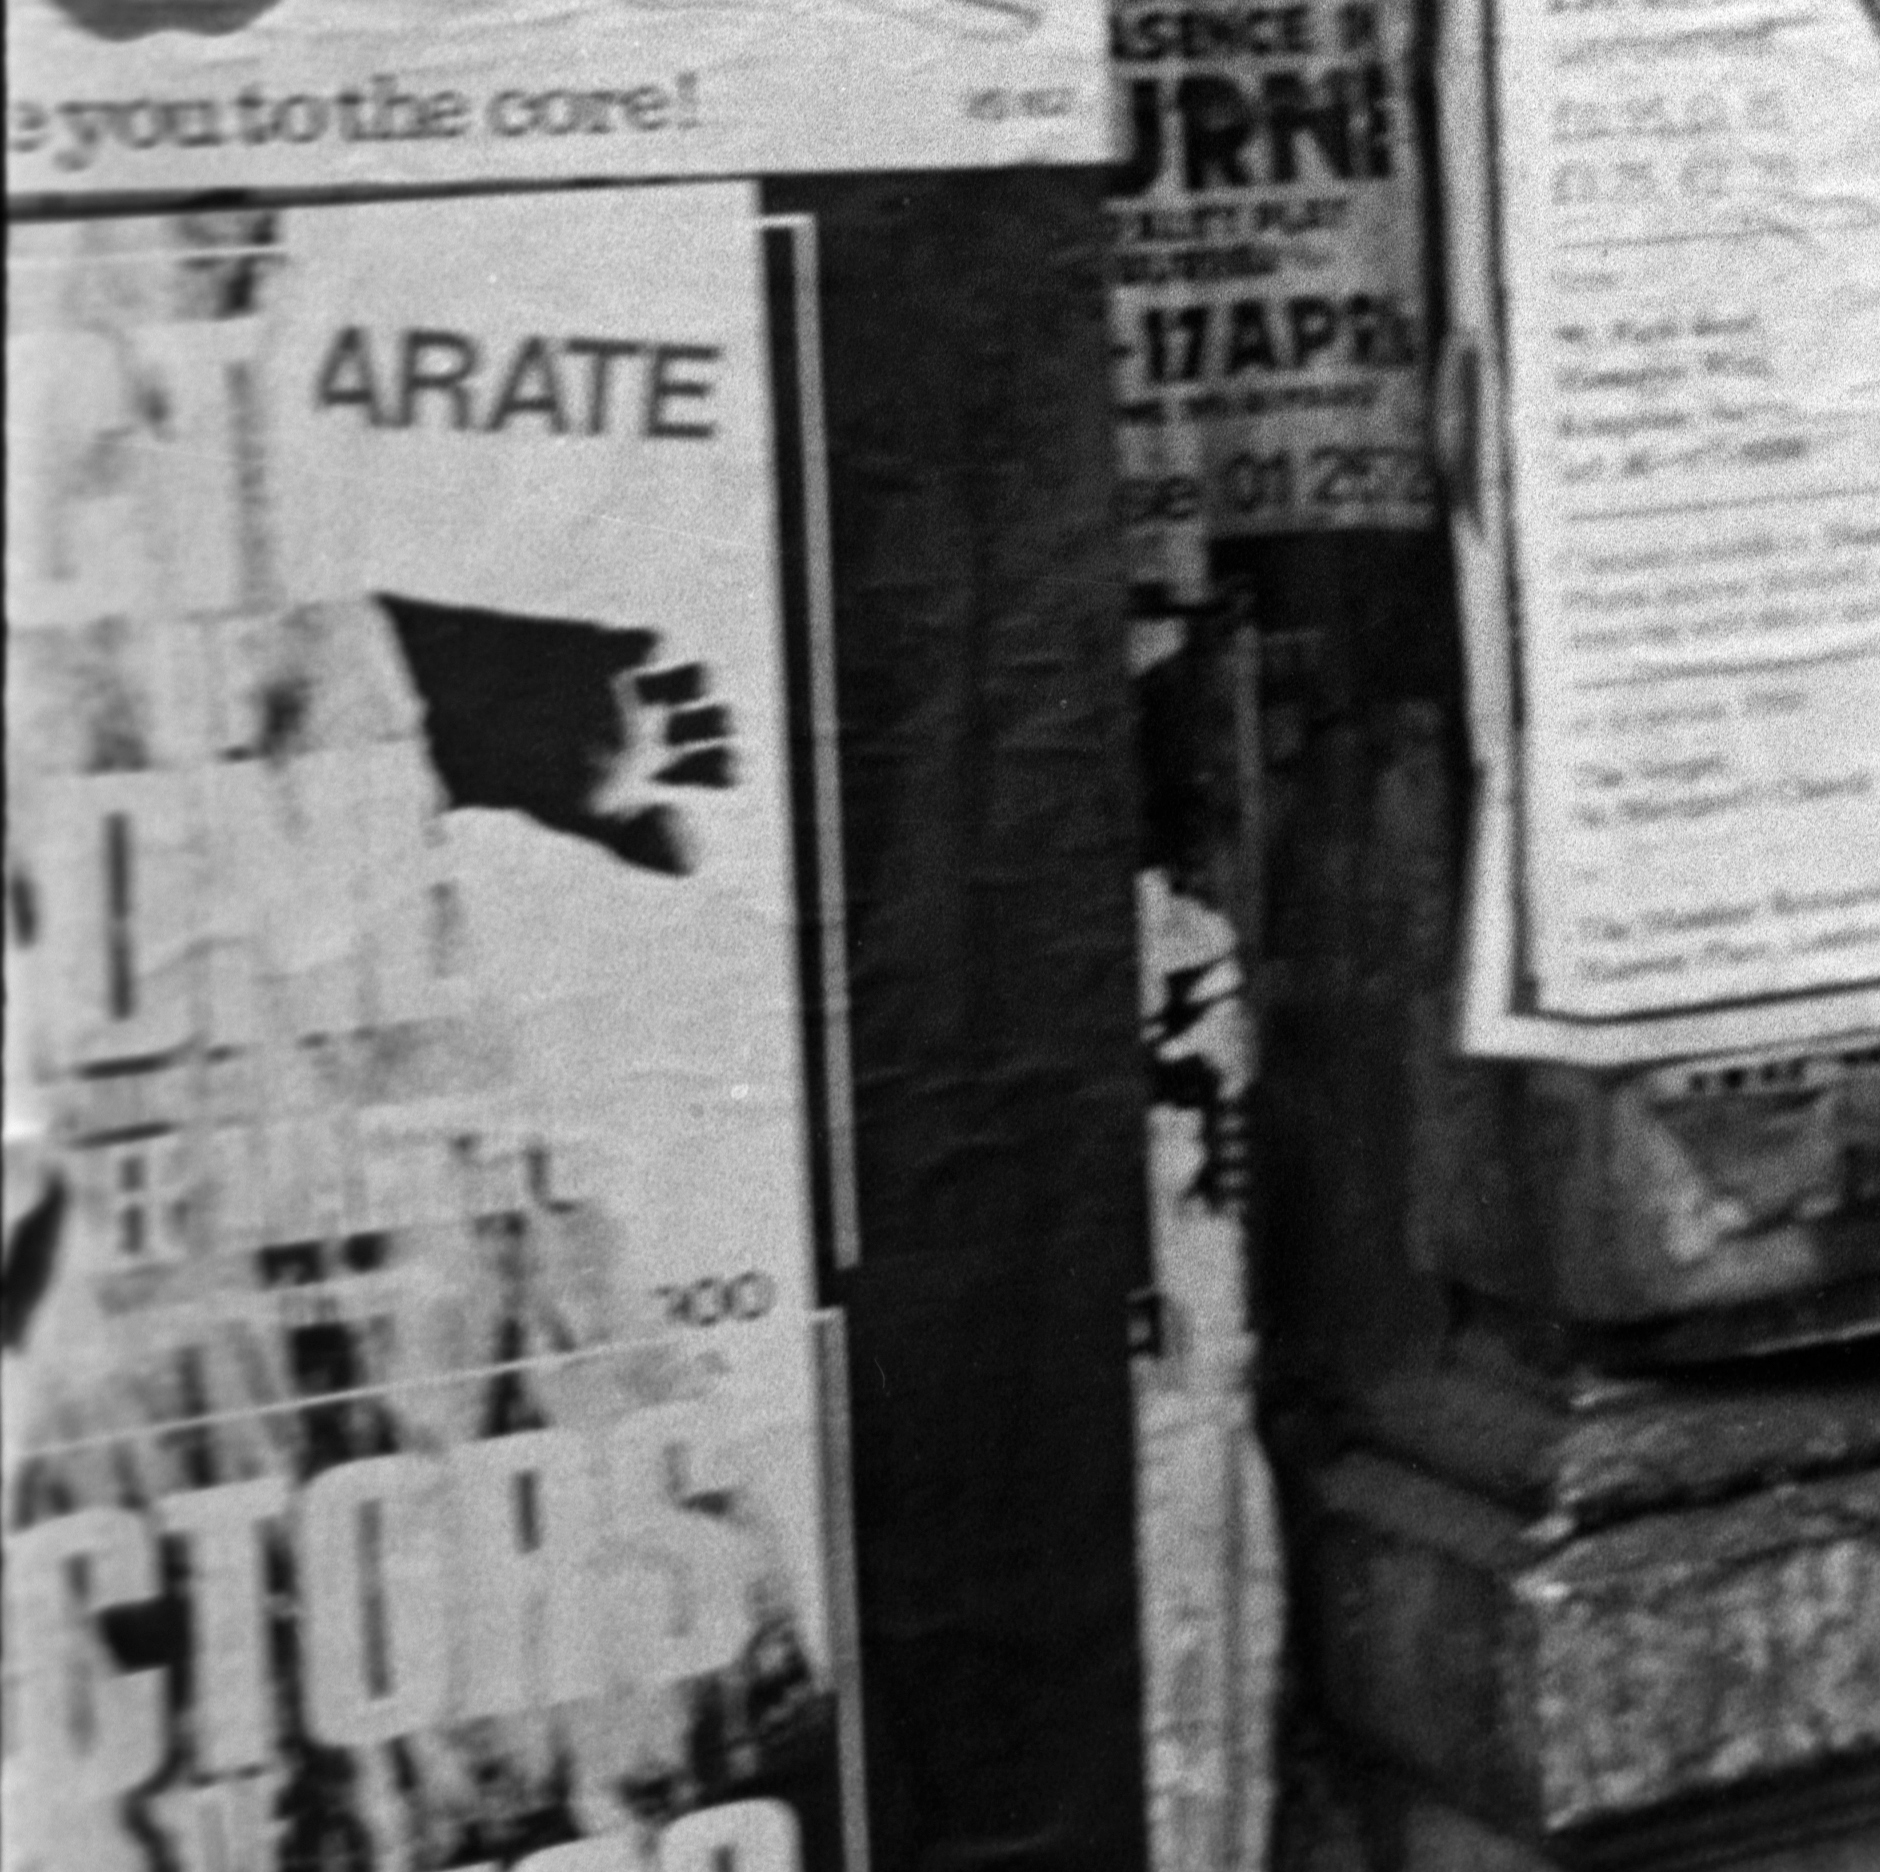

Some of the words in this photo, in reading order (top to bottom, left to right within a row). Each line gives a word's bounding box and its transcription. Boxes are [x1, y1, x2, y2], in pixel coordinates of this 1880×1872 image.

[58, 101, 221, 172] you
[237, 101, 332, 150] to
[341, 72, 470, 143] the
[485, 72, 701, 141] core!
[314, 326, 724, 440] ARATE
